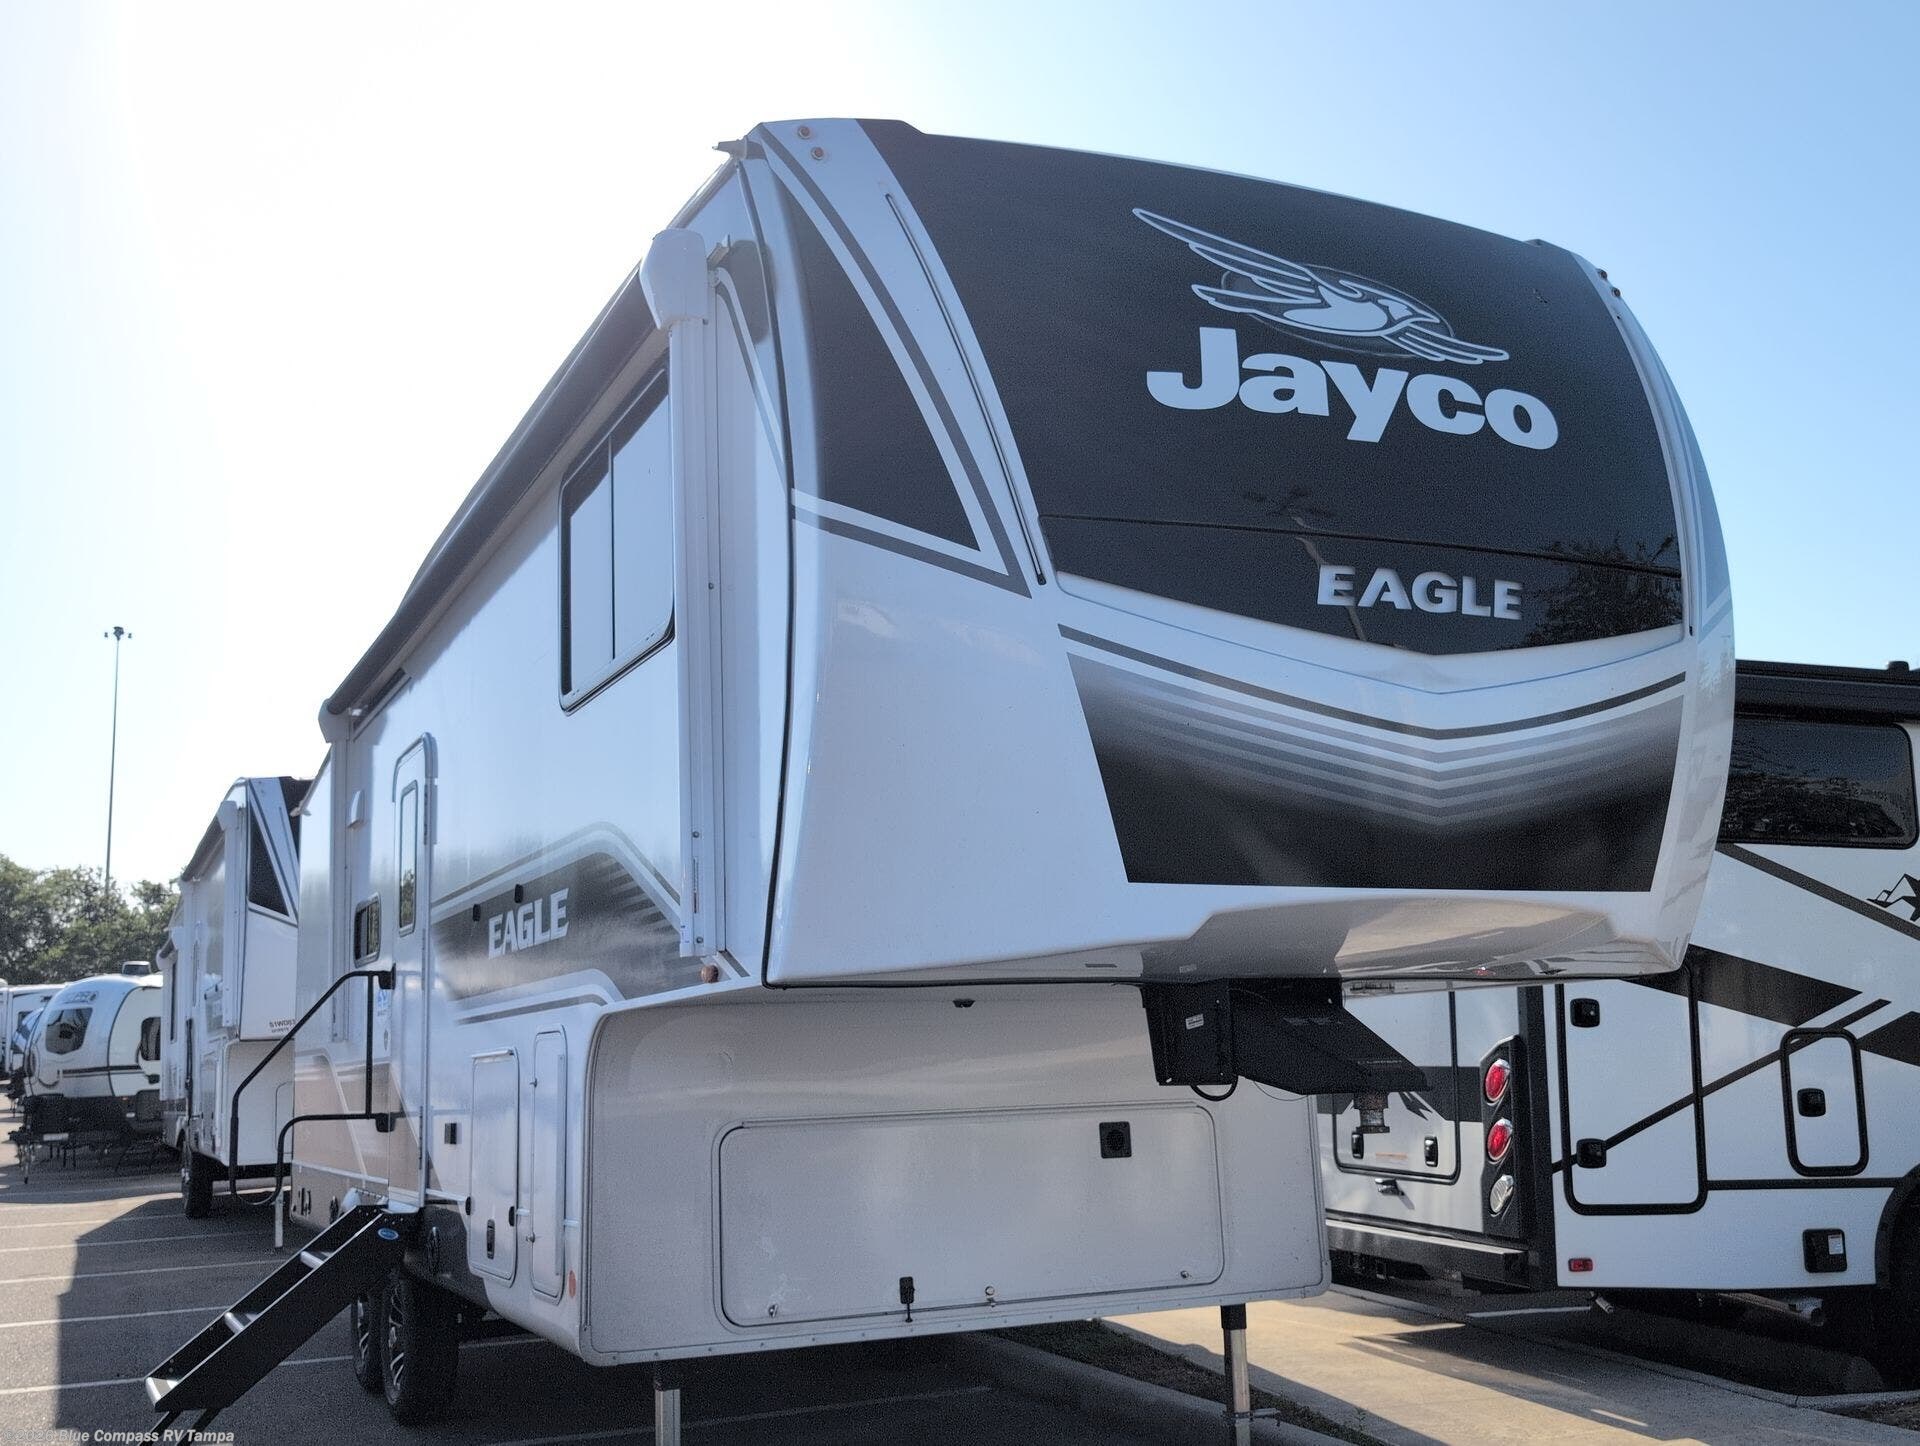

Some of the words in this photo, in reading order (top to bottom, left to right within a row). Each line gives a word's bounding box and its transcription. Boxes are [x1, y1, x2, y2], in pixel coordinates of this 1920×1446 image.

[1146, 326, 1559, 451] Jayco
[1316, 564, 1525, 621] EAGLE
[488, 887, 570, 960] EAGLE
